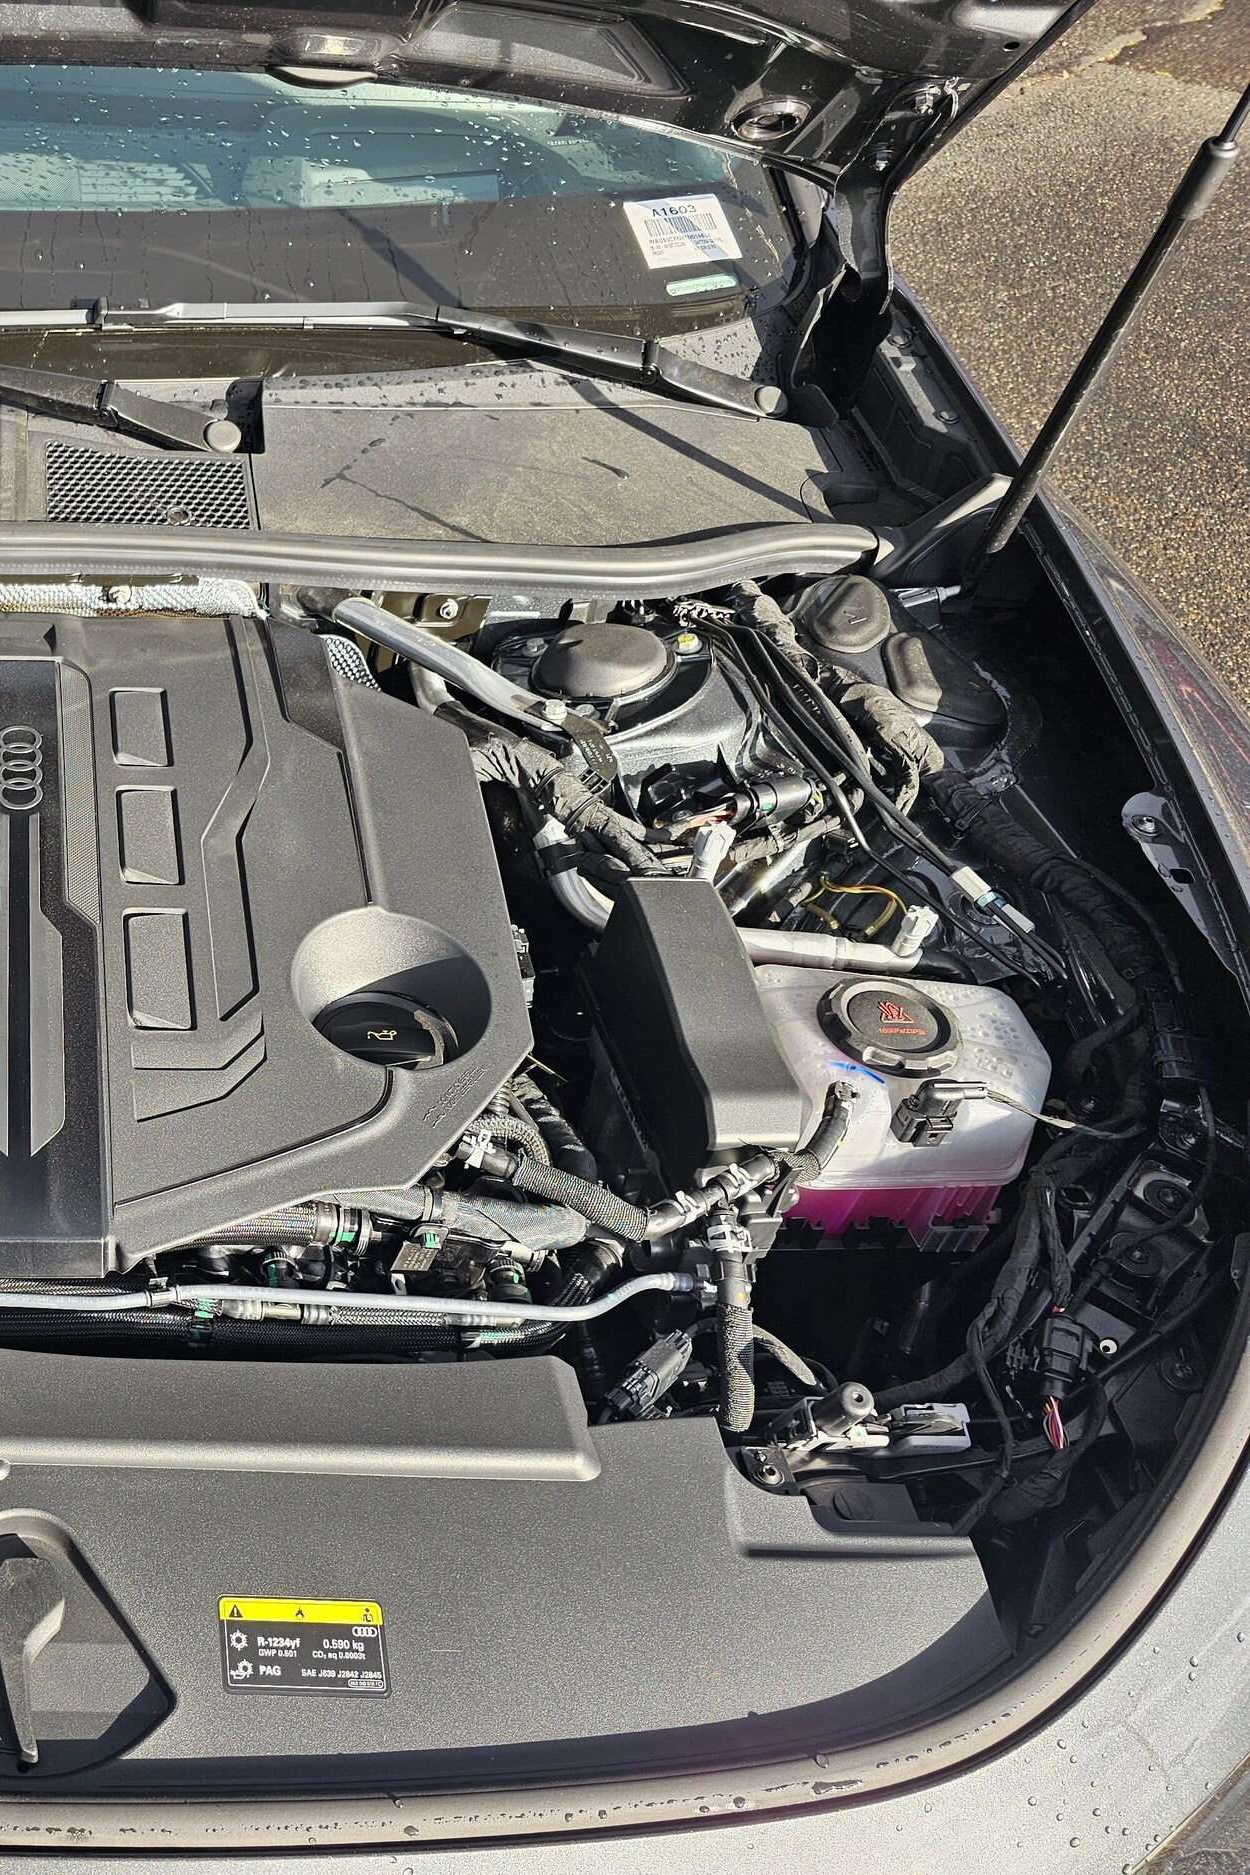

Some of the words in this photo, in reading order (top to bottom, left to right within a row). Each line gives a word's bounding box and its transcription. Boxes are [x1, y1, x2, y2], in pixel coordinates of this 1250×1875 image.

[652, 205, 696, 217] A1603
[257, 1636, 300, 1648] R-1234yf
[323, 1639, 350, 1650] 0.590
[352, 1640, 364, 1652] kg
[259, 1666, 281, 1676] PAG
[302, 1669, 317, 1677] SAE
[338, 1670, 359, 1678] J2842
[360, 1671, 382, 1679] J2845
